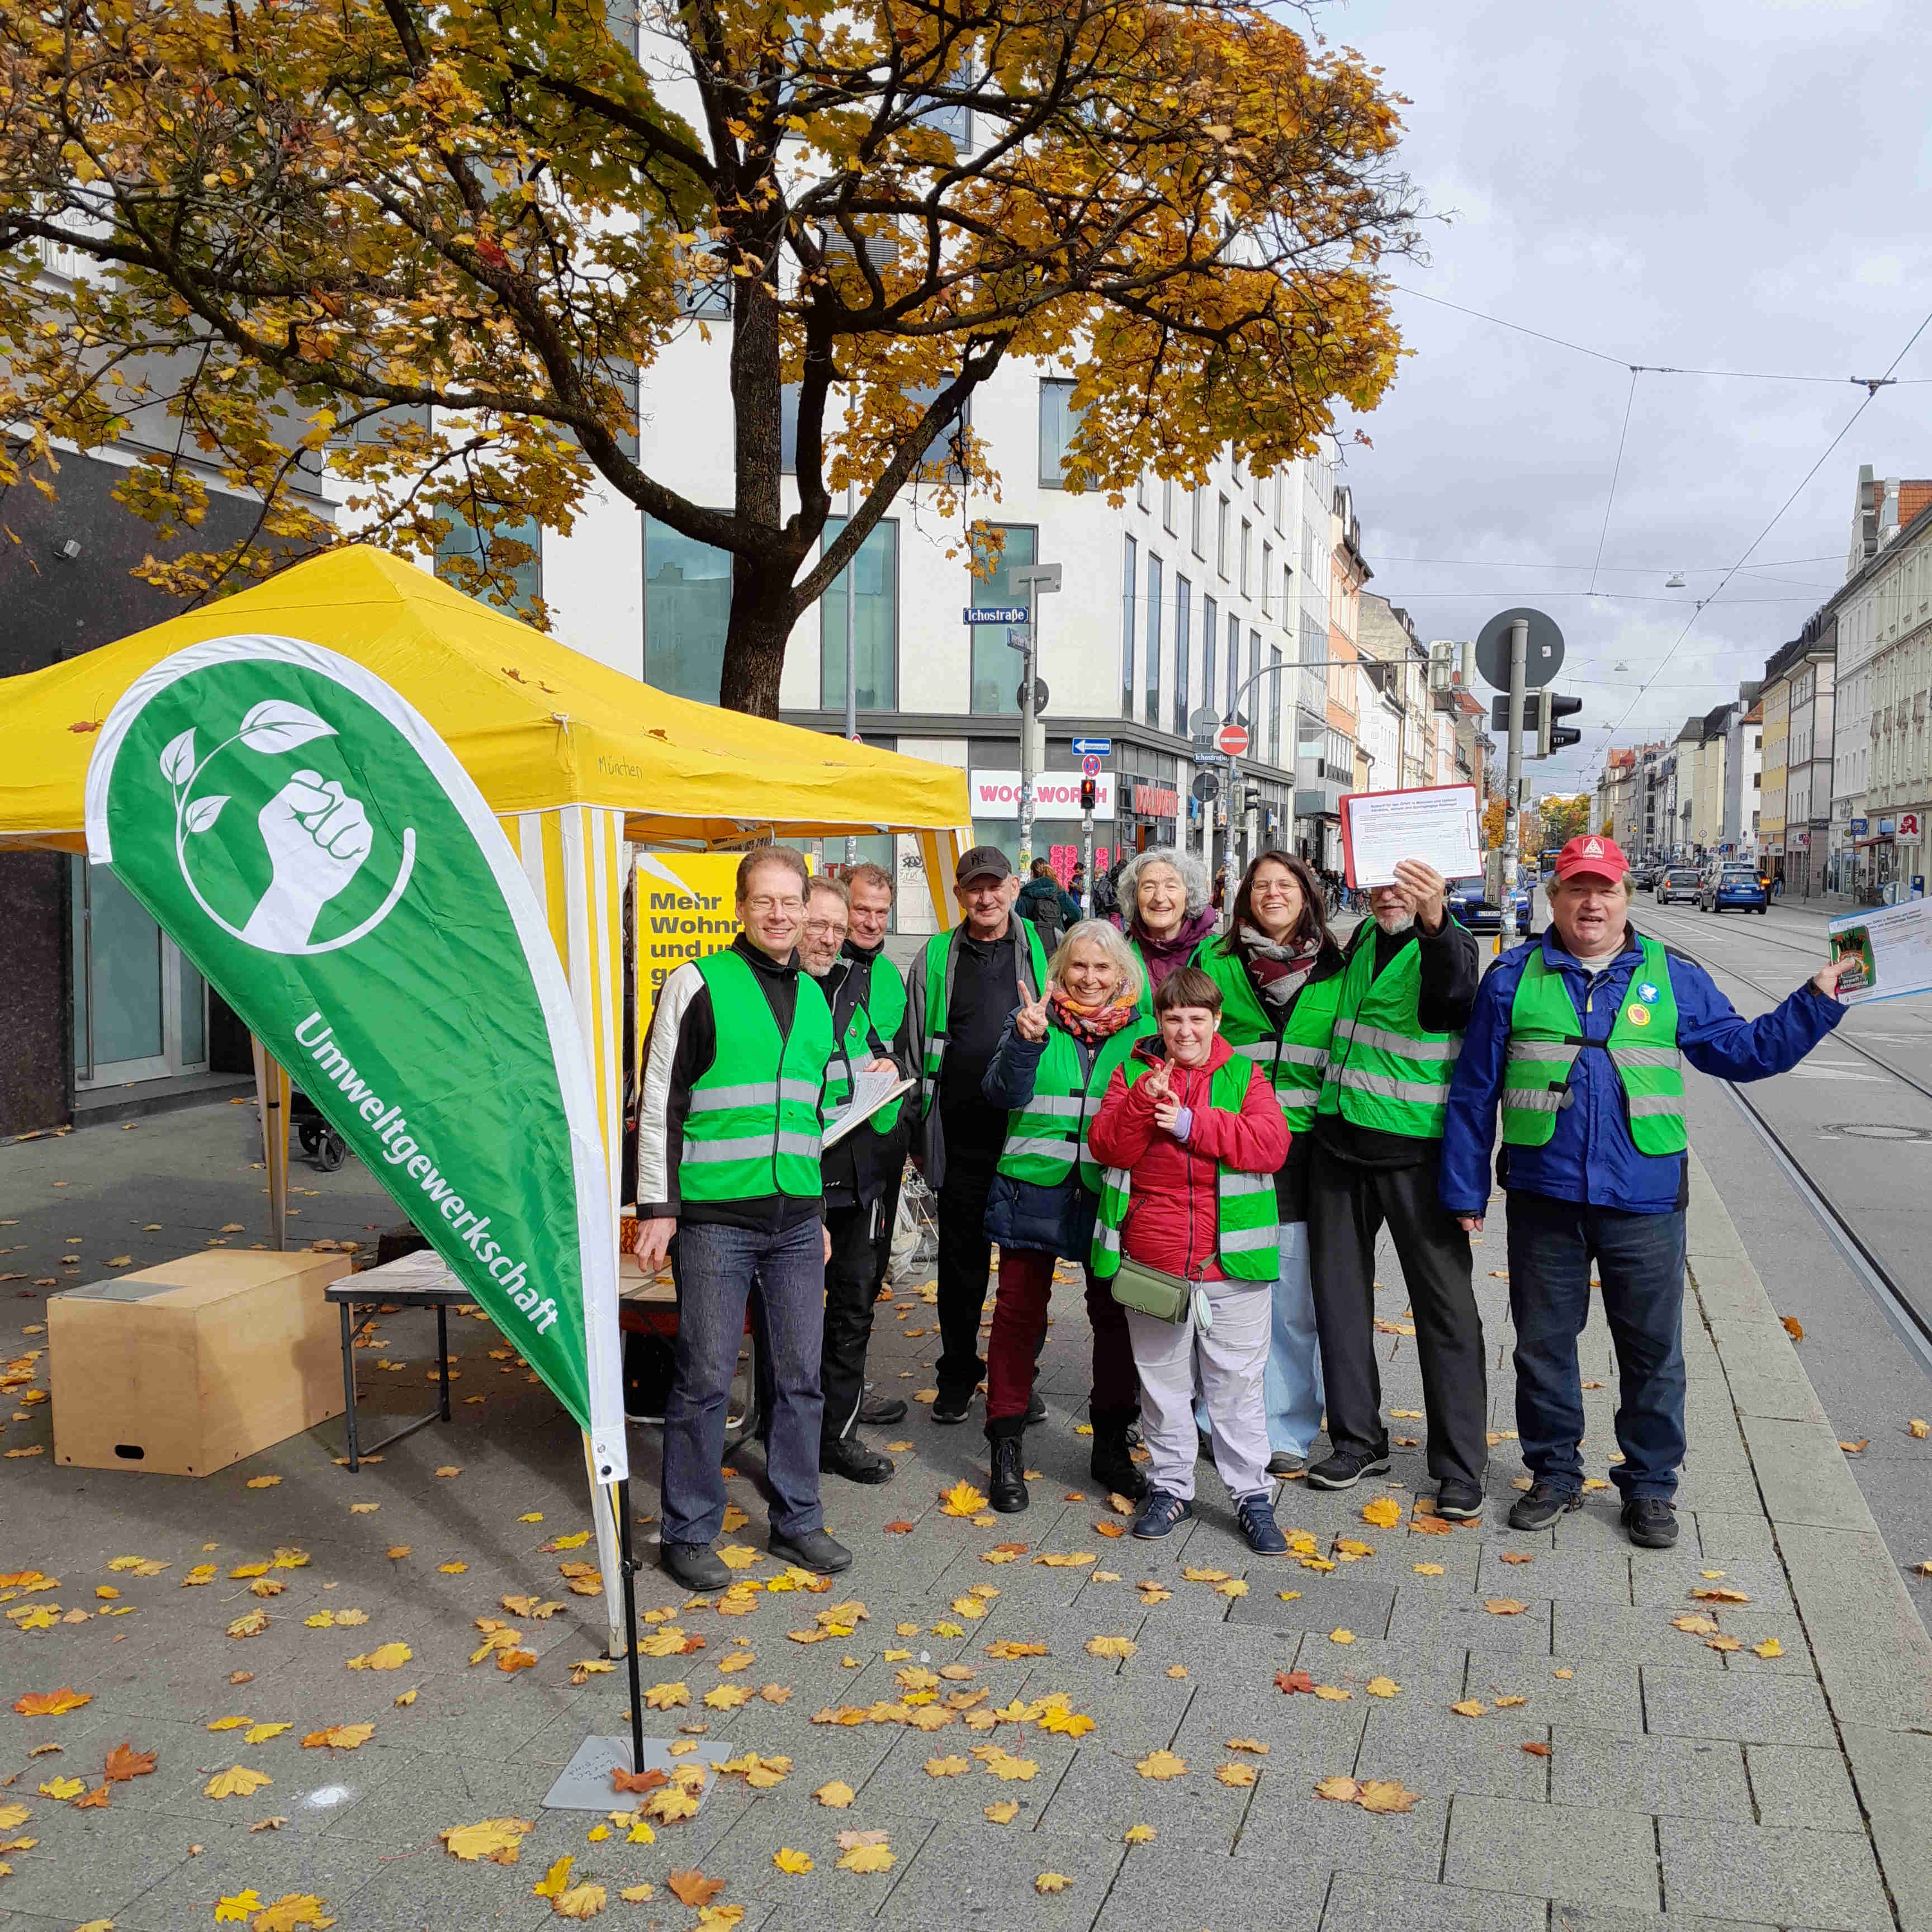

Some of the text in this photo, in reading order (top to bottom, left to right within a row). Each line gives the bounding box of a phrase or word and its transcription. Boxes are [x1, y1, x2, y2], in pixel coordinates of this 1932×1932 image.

[968, 609, 1024, 622] Ichostraße
[599, 755, 642, 778] München
[979, 785, 1107, 804] WOOWORH
[650, 892, 722, 910] Mehr
[650, 916, 744, 934] Wohnr
[651, 940, 701, 958] und
[295, 1011, 558, 1336] Umweltgewerkschaft
